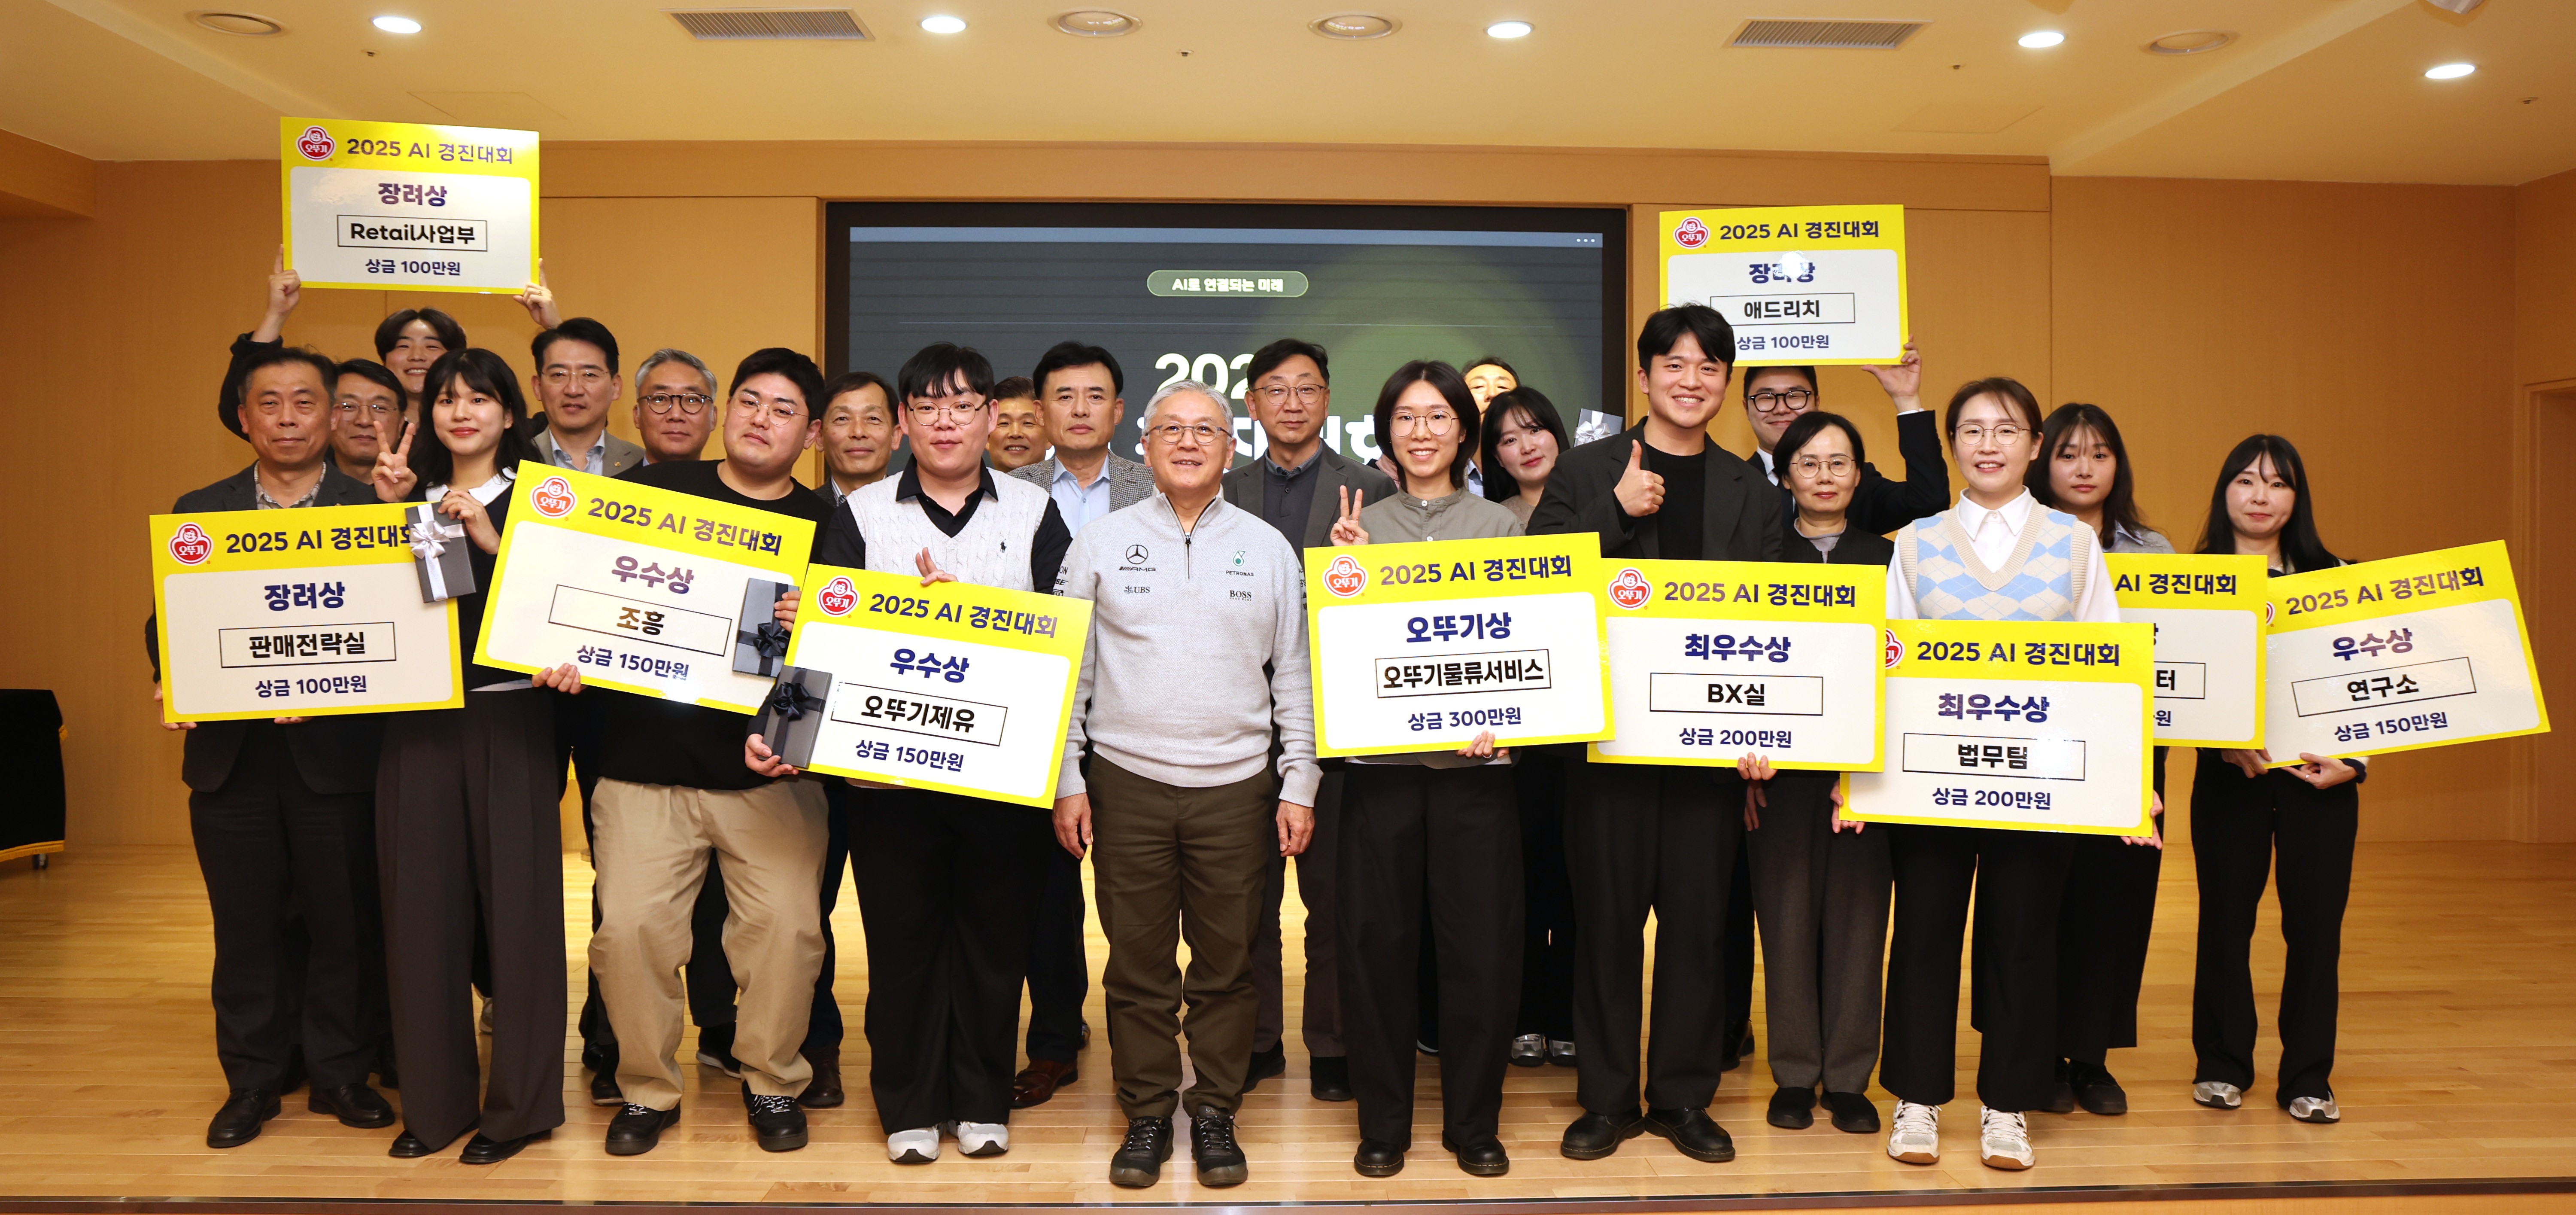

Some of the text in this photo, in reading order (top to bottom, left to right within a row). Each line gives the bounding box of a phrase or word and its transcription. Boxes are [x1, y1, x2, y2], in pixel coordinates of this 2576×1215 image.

[305, 143, 328, 154] 오뚜기
[347, 139, 512, 164] 2025 AI 경진대회
[378, 183, 447, 207] 장려상
[351, 223, 475, 244] Retail사업부
[1681, 233, 1702, 242] 오뚜기
[1720, 221, 1878, 239] 2025 AI 경진대회
[365, 259, 460, 275] 상금 100만원
[1172, 278, 1283, 292] AI로 연결되는 미래
[1744, 300, 1819, 319] 애드리치
[1737, 335, 1829, 350] 상금 100만원
[1155, 353, 1254, 399] 202
[540, 496, 565, 511] 오뚜기
[588, 498, 782, 556] 2025 AI 경진대회
[179, 544, 204, 556] 오뚜기
[226, 532, 288, 553] 2025
[296, 530, 322, 549] AI
[611, 556, 694, 594] 우수상
[1333, 576, 1358, 588] 오뚜기
[1381, 555, 1571, 585] 2025 AI 경진대회
[264, 582, 345, 611] 장려상
[1230, 590, 1252, 599] BOSS
[1617, 589, 1643, 600] 오뚜기
[1665, 582, 1855, 607] 2025 AI 경진대회
[2115, 574, 2236, 595] AI 경진대회
[2286, 566, 2484, 615] 2025 AI 경진대회
[825, 595, 850, 609] 오뚜기
[617, 606, 665, 636] 조흥
[869, 594, 1057, 638] 2025 AI 경진대회
[1406, 612, 1511, 643] 오뚜기상
[249, 632, 365, 658] 판매전략실
[1685, 634, 1791, 663] 최우수상
[1918, 642, 2119, 666] 2025 AI 경진대회
[2333, 628, 2412, 661] 우수상
[577, 646, 689, 680] 상금 150만원
[890, 649, 969, 683] 우수상
[1383, 659, 1544, 689] 오뚜기물류서비스
[255, 676, 366, 697] 상금 100만원
[1708, 684, 1765, 706] BX실
[2347, 673, 2418, 701] 연구소
[861, 696, 975, 733] 오뚜기제유
[1408, 707, 1521, 731] 상금 300만원
[1938, 693, 2050, 723] 최우수상
[1680, 728, 1791, 748] 상금 200만원
[2335, 712, 2448, 741] 상금 150만원
[856, 740, 963, 772] 상금 150만원
[1958, 744, 2027, 769] 법무팀
[1932, 788, 2050, 810] 상금 200만원
